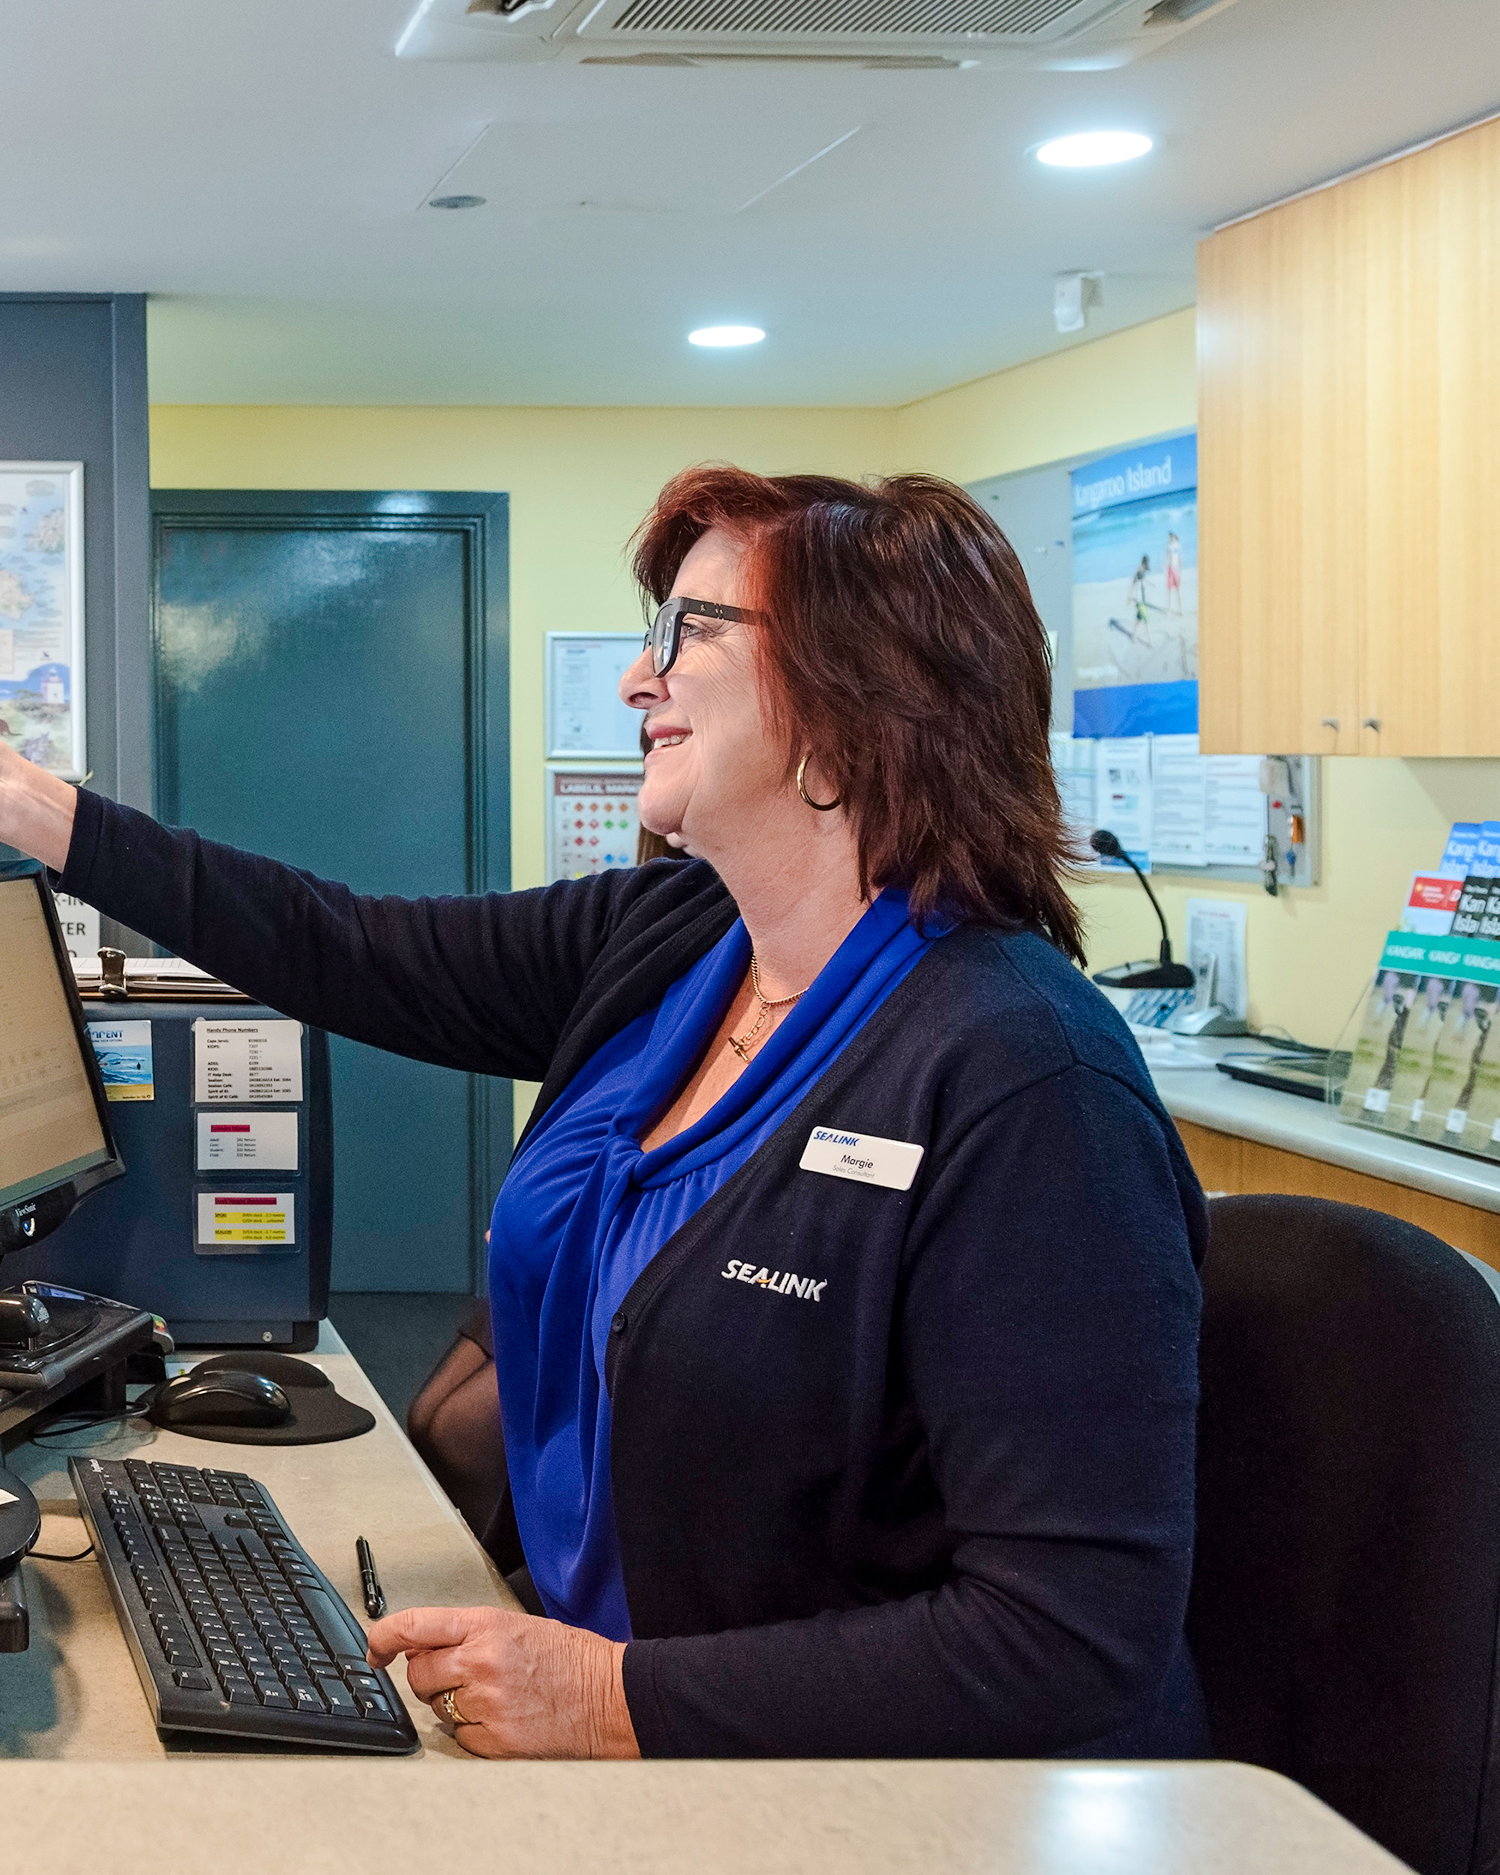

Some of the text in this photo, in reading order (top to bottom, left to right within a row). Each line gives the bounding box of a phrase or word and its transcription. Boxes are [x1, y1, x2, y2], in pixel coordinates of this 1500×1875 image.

[1127, 455, 1172, 491] Island
[813, 1131, 860, 1147] SEALINK
[840, 1154, 874, 1169] Margie
[832, 1164, 875, 1179] Sales Consultant
[15, 1203, 37, 1217] ViewSonic
[721, 1259, 828, 1302] SEALINK
